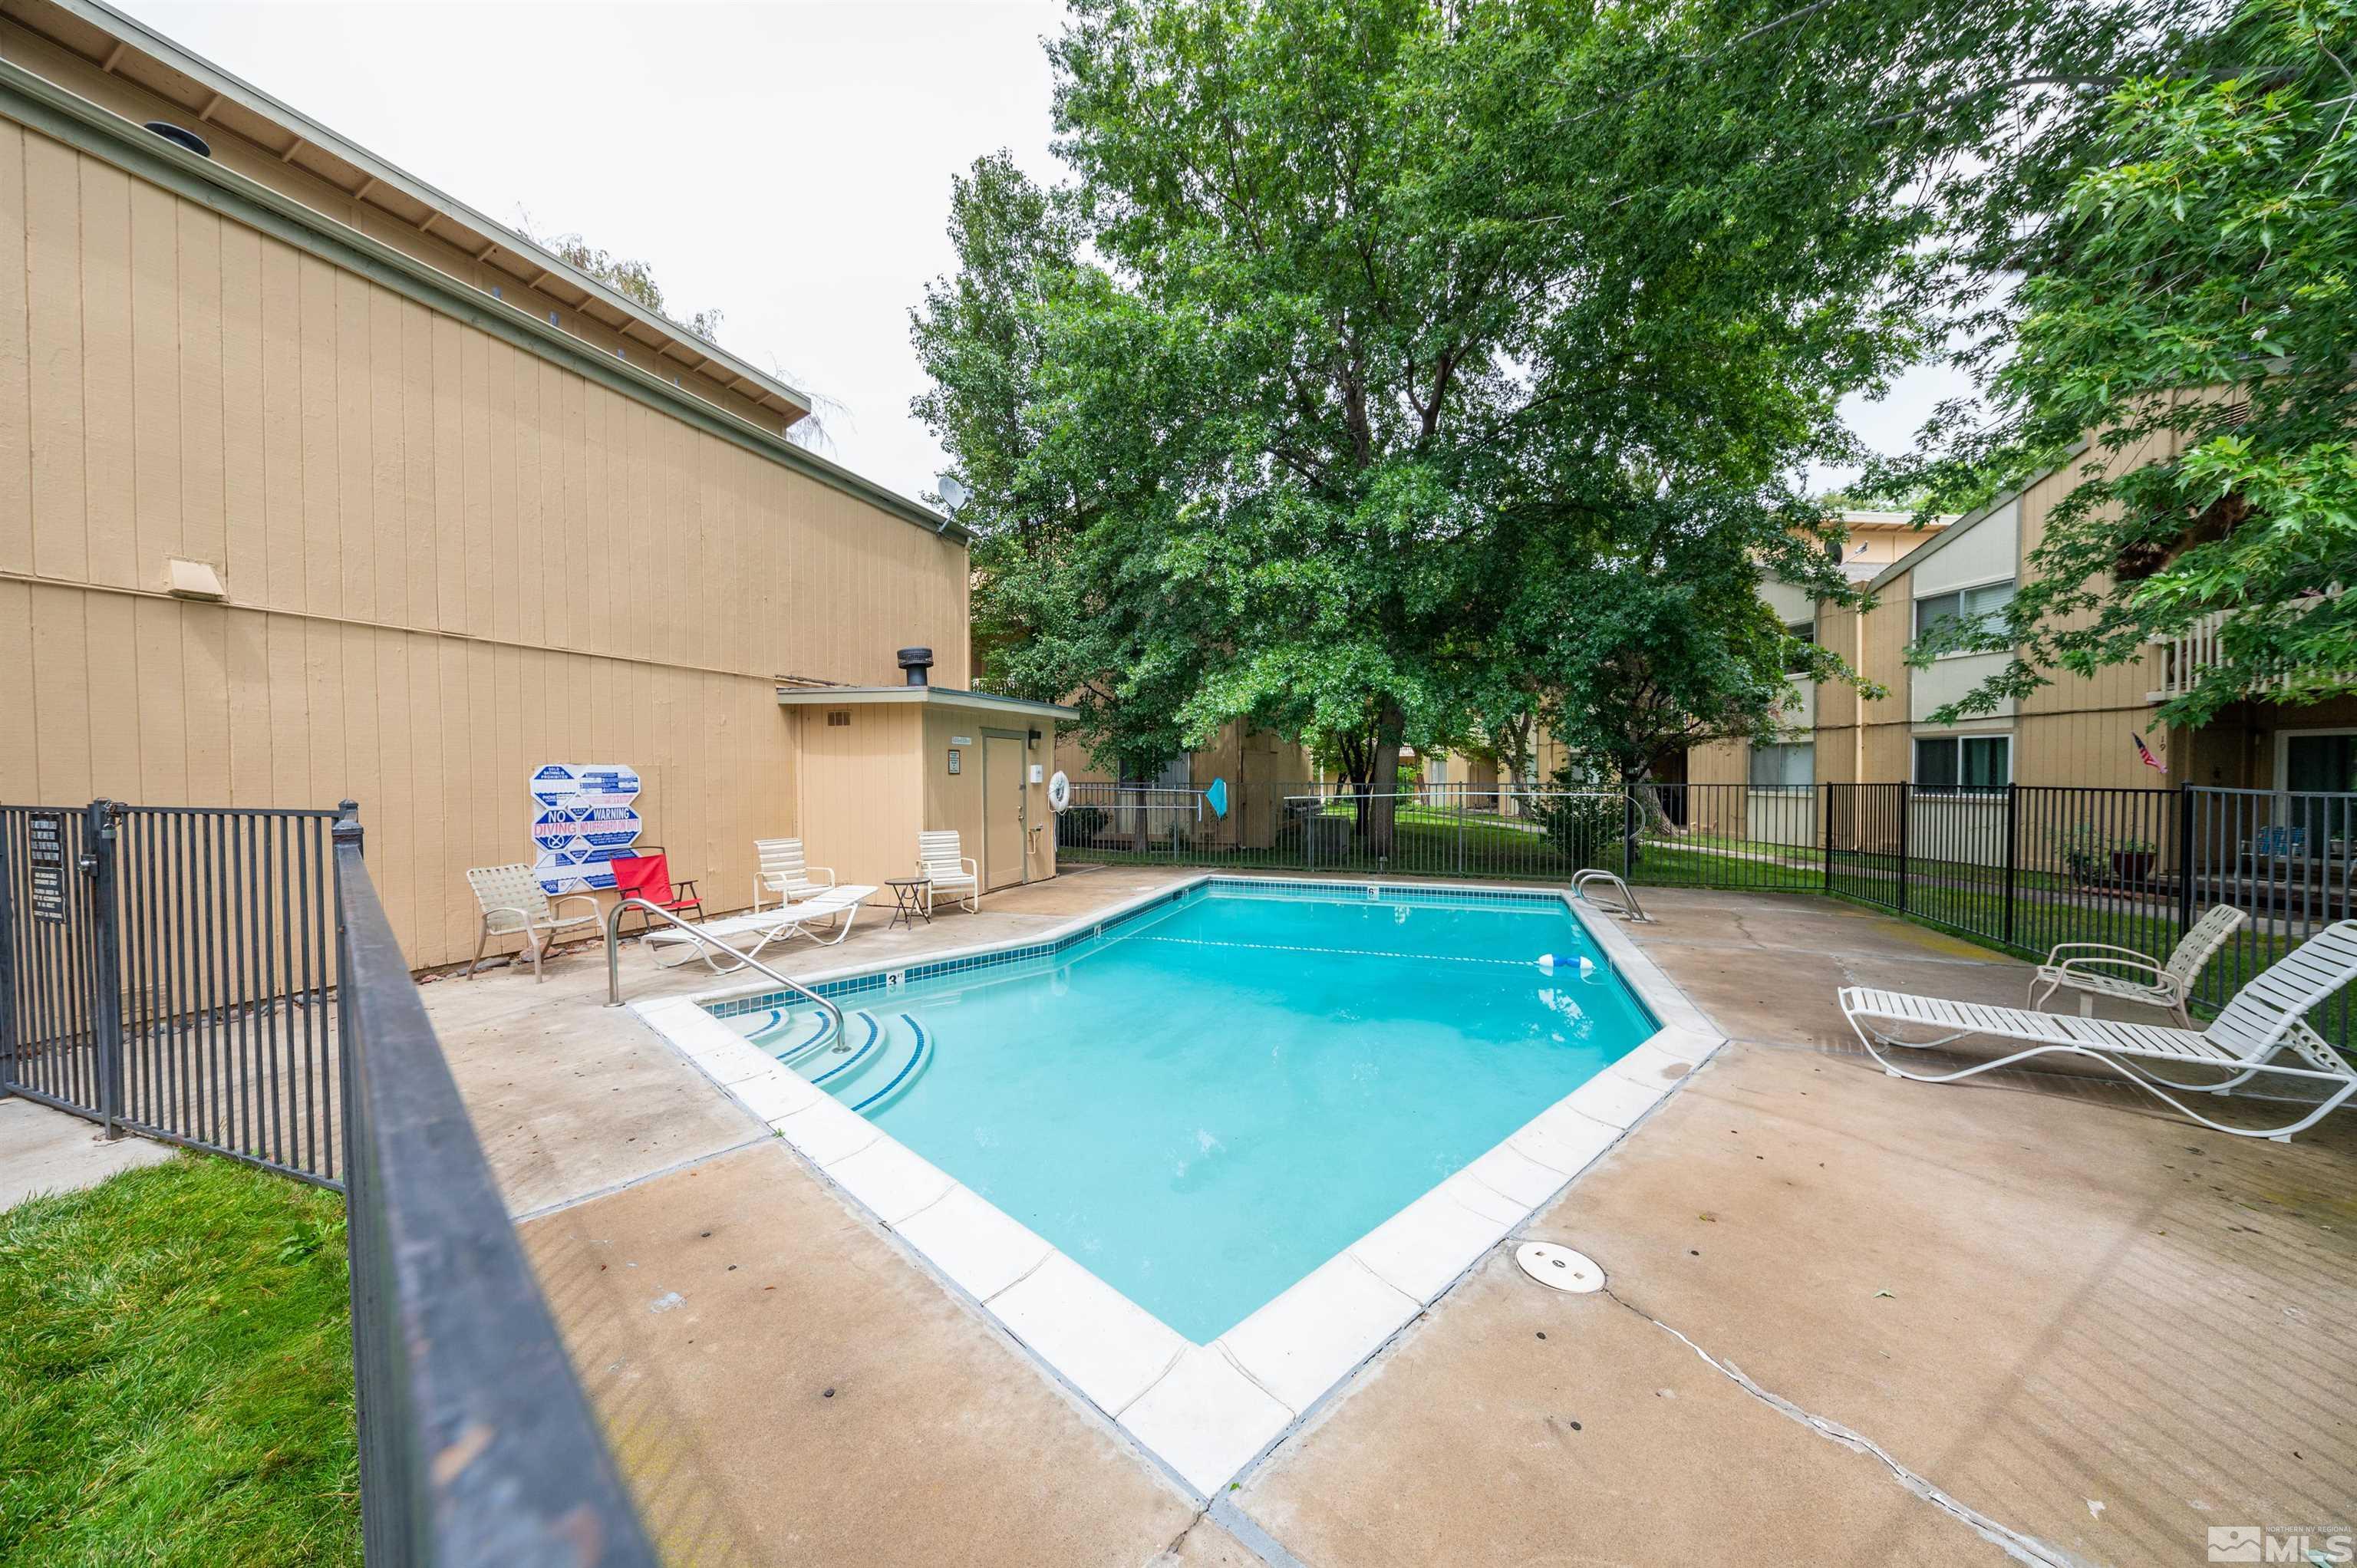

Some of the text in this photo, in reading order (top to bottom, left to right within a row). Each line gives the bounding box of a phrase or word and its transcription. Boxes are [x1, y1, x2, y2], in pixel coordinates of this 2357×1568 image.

[2160, 736, 2166, 751] 19
[548, 810, 566, 823] NO
[594, 808, 629, 821] WARNING
[534, 823, 576, 836] DIVING
[580, 819, 639, 834] NO LIFEGUARD ON DUTY
[888, 975, 896, 985] 3
